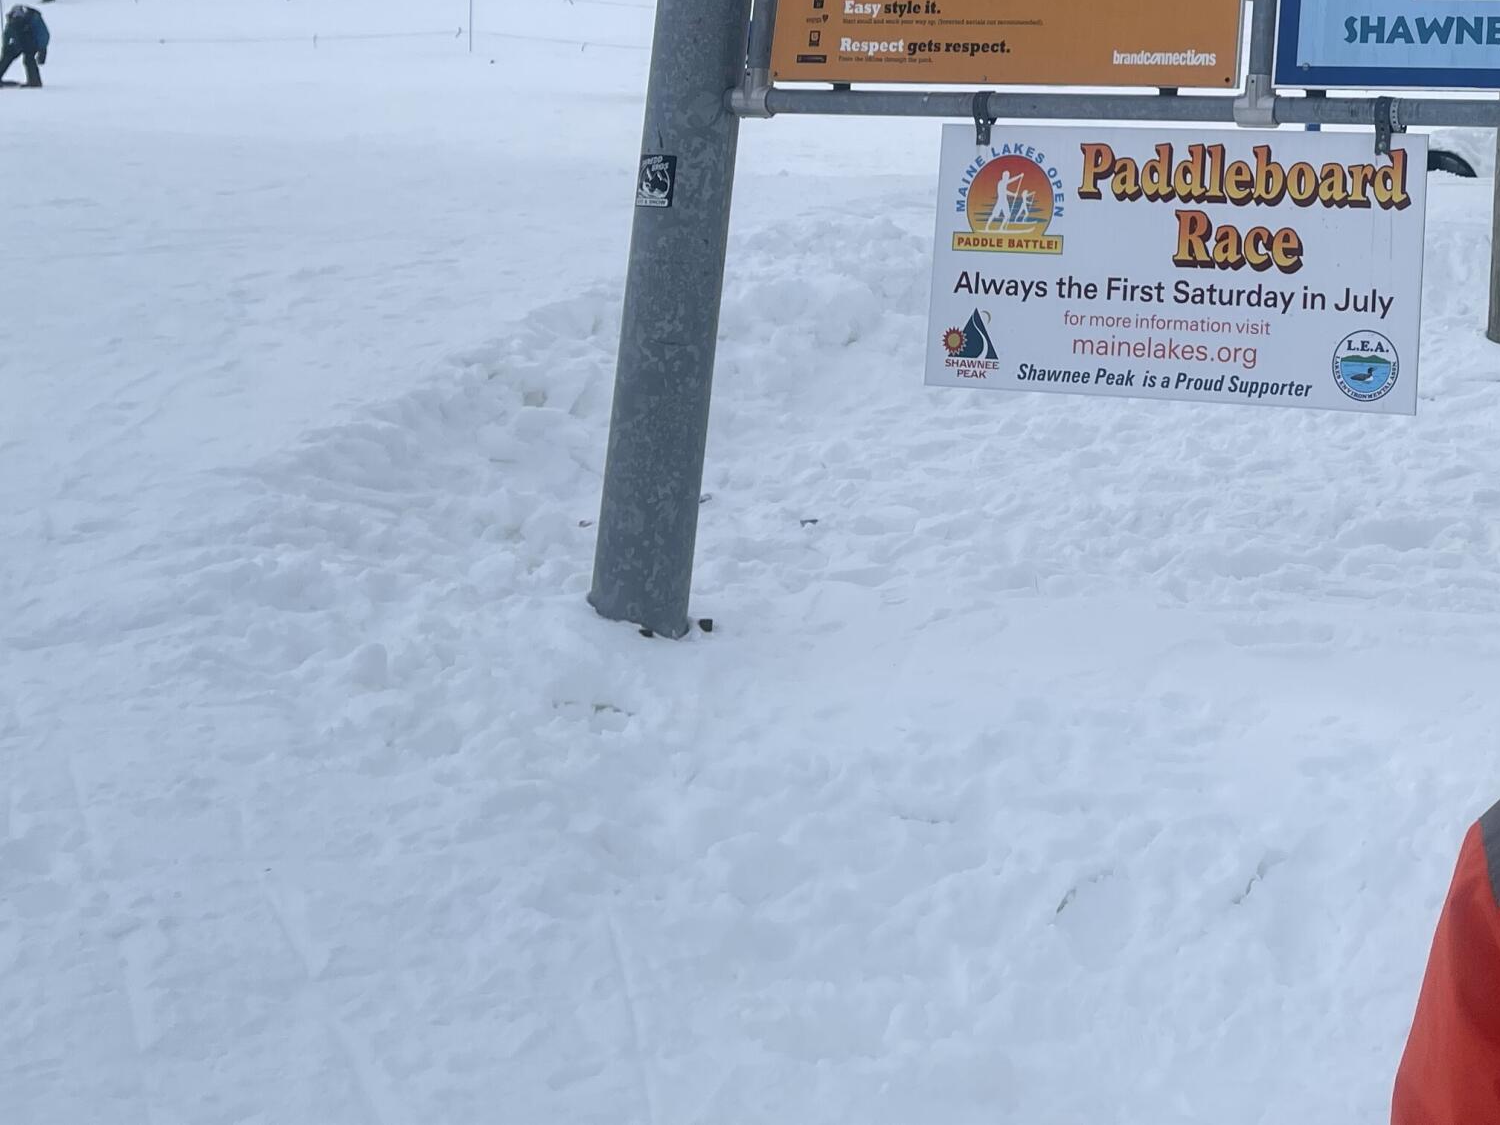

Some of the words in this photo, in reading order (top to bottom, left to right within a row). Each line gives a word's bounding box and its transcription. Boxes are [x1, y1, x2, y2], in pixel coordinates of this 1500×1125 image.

[843, 0, 881, 18] Easy
[884, 0, 921, 18] style
[925, 0, 942, 15] it.
[840, 37, 905, 56] Respect
[907, 41, 941, 57] gets
[944, 39, 1011, 57] respect.
[1113, 49, 1216, 66] brandconnections
[991, 143, 1045, 164] LAKES
[956, 154, 985, 212] MAINE
[1078, 142, 1412, 210] Paddleboard
[1048, 167, 1064, 217] OPEN
[957, 236, 1003, 249] PADDLE
[1008, 238, 1058, 250] BATTLE!
[1172, 209, 1303, 273] Race
[953, 271, 1048, 301] Always
[1056, 275, 1098, 300] the
[1106, 277, 1165, 302] First
[1173, 280, 1295, 314] Saturday
[1302, 285, 1327, 310] in
[1334, 287, 1394, 319] July
[1064, 311, 1085, 326] for
[1089, 315, 1130, 329] more
[1135, 314, 1232, 334] information
[1236, 320, 1271, 335] visit
[1072, 336, 1258, 369] mainelakes.org
[1346, 340, 1389, 353] L.E.A.
[945, 358, 999, 370] SHAWNEE
[957, 368, 987, 379] PEAK
[1017, 363, 1091, 384] Shawnee
[1094, 367, 1135, 387] Peak
[1143, 371, 1156, 388] is
[1160, 375, 1171, 389] a
[1175, 372, 1224, 393] Proud
[1228, 375, 1312, 399] Supporter
